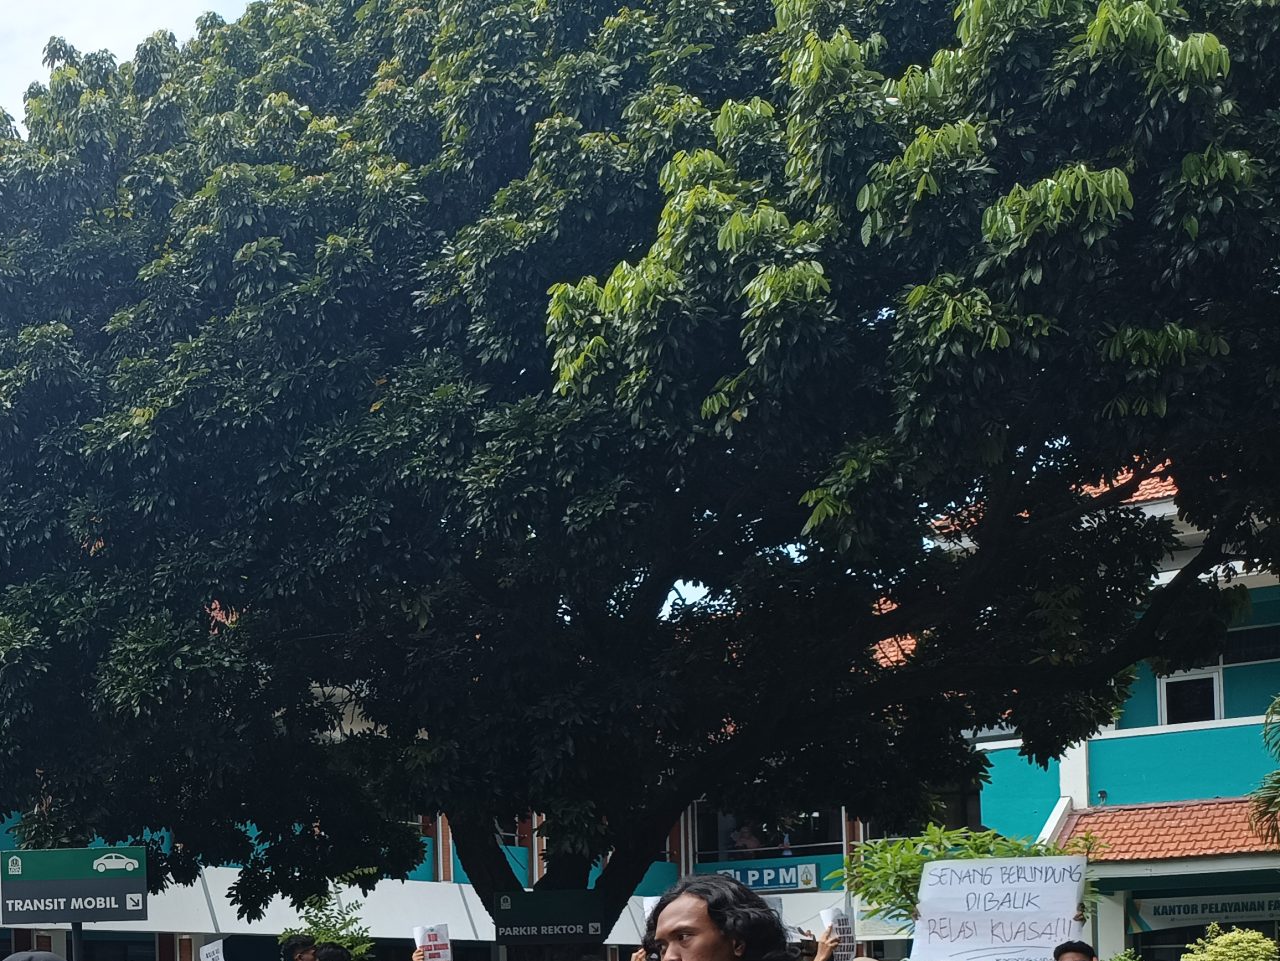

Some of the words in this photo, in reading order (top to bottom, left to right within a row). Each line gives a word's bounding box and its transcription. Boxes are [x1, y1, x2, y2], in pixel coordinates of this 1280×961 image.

[928, 866, 993, 886] SENANG
[1000, 865, 1082, 884] BERLINDUNG
[6, 898, 66, 912] TRANSIT
[71, 896, 119, 910] MOBIL
[966, 891, 1040, 911] DIBALIK
[1153, 904, 1199, 916] KANTOR
[1201, 900, 1265, 914] PELAYANAN
[499, 926, 538, 936] PARKIR
[541, 924, 583, 935] REKTOR
[928, 917, 977, 944] RELASI
